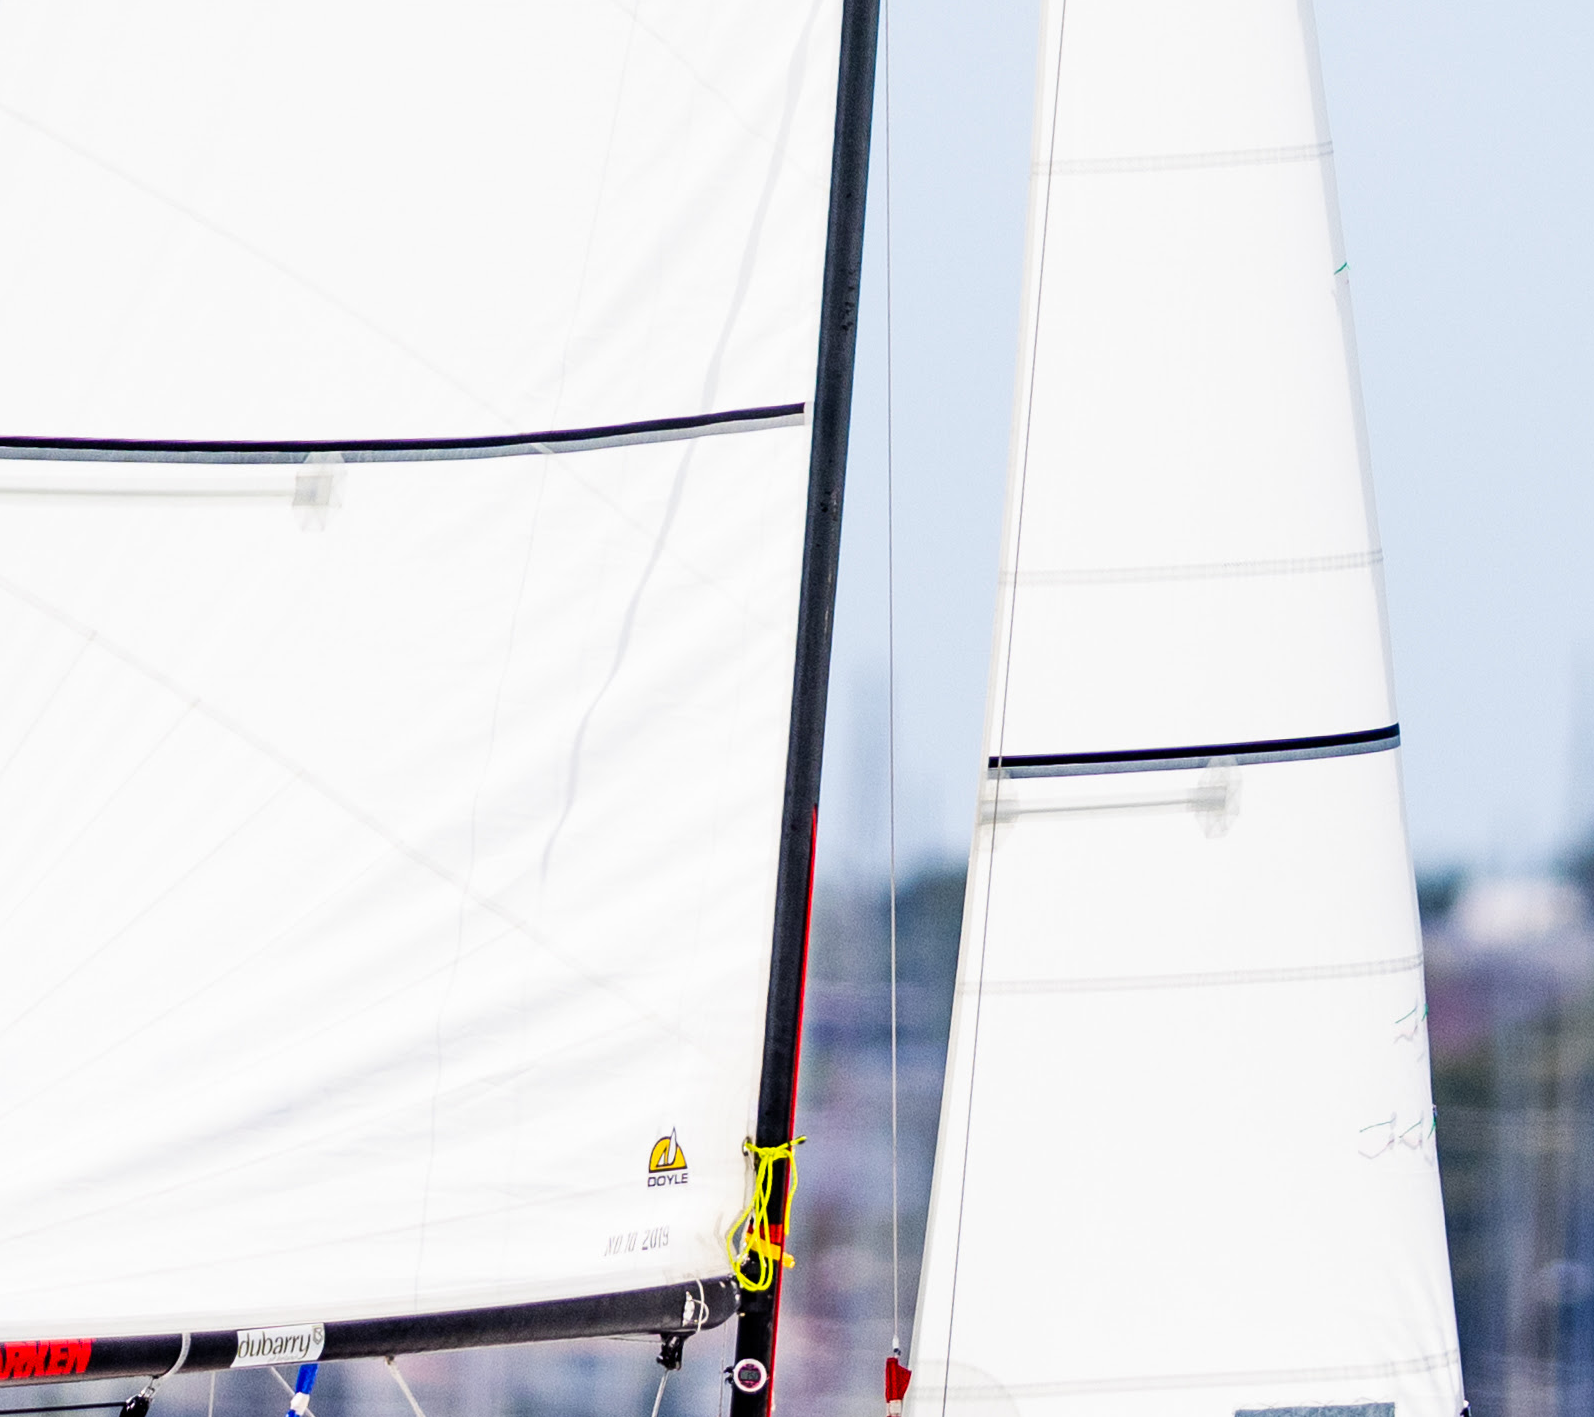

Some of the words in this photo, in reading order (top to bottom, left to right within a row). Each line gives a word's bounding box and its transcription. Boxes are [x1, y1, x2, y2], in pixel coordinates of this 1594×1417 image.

[647, 1173, 688, 1187] DOYLE
[642, 1225, 670, 1251] 2019
[237, 1331, 311, 1359] dubarry
